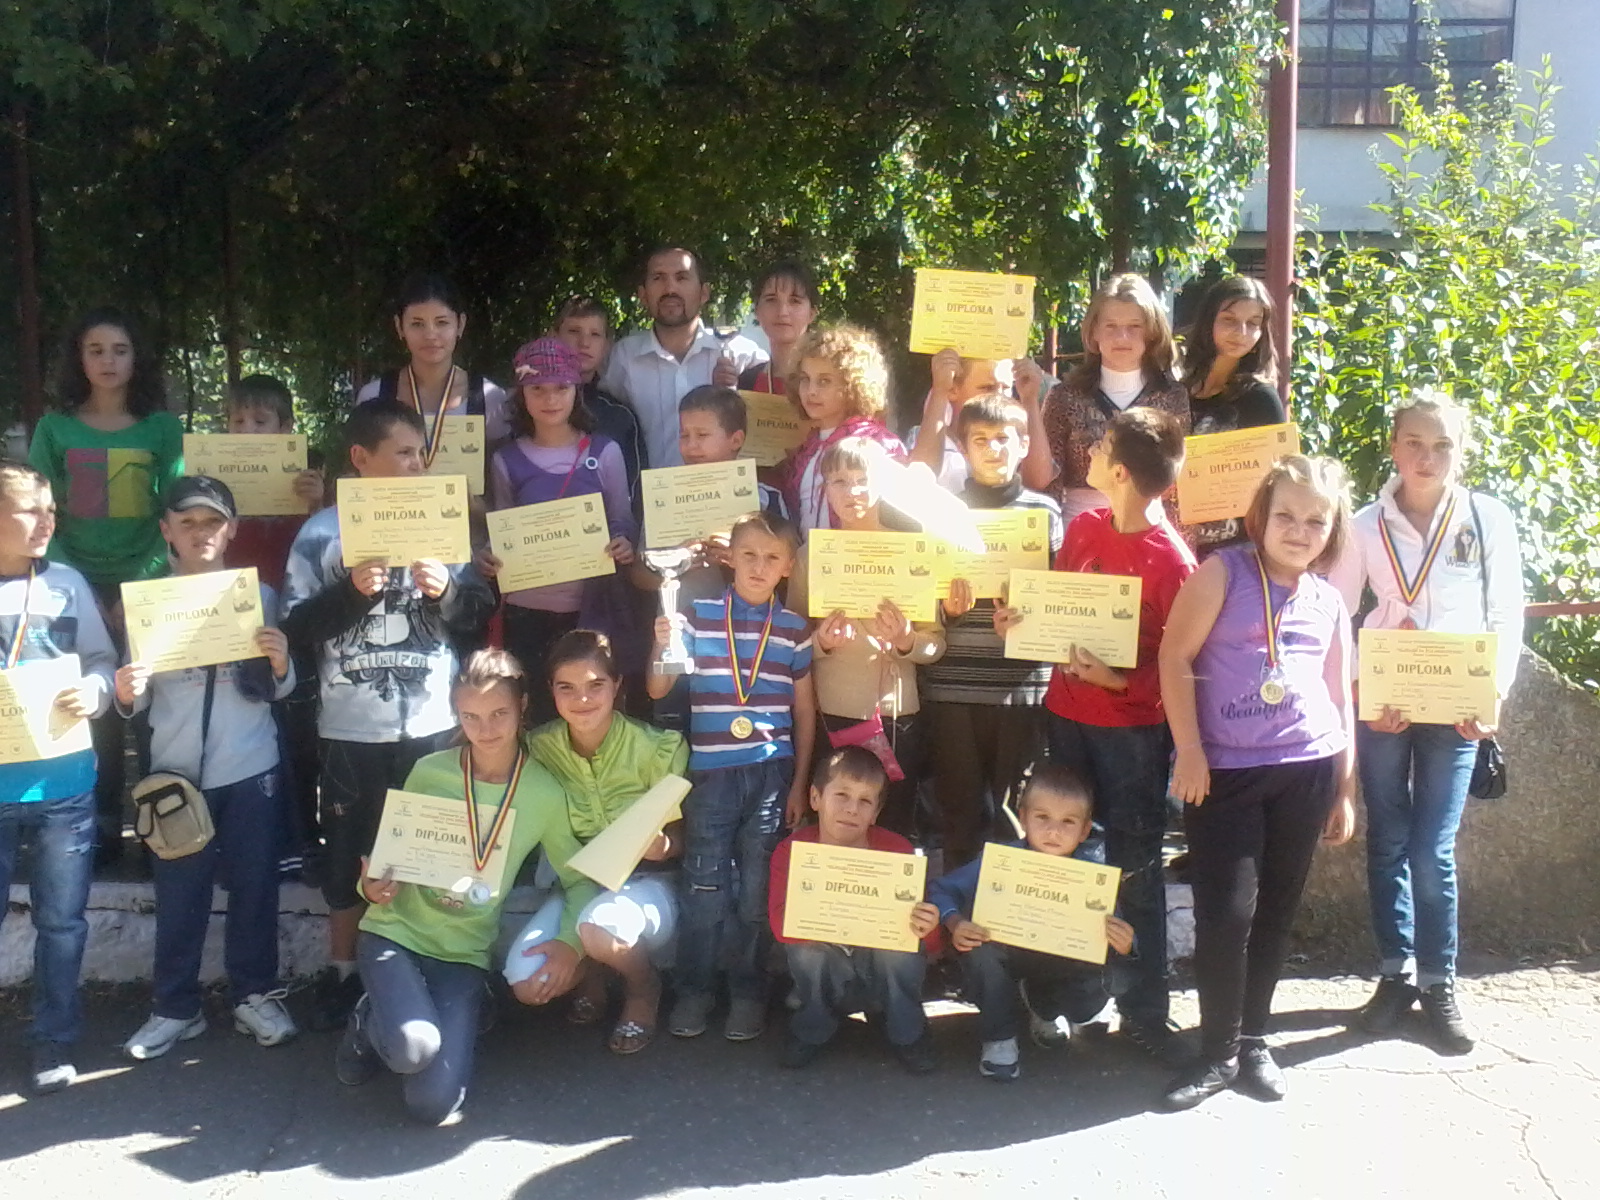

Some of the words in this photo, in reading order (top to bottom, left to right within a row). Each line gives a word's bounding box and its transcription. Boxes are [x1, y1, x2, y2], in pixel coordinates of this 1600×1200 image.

[946, 303, 994, 315] DIPLOMA
[756, 419, 799, 430] DIPLOMA
[218, 464, 268, 474] DIPLOMA
[1209, 459, 1261, 474] DIPLOMA
[675, 490, 721, 504] DIPLOMA
[374, 510, 427, 521] DIPLOMA
[523, 528, 571, 545] DIPLOMA
[844, 564, 895, 575] DIPLOMA
[164, 607, 220, 622] DIPLOMA
[1044, 604, 1097, 617] DIPLOMA
[1396, 663, 1452, 675] DIPLOMA
[415, 828, 467, 845] DIPLOMA
[825, 881, 879, 897] DIPLOMA
[1015, 884, 1070, 905] DIPLOMA
